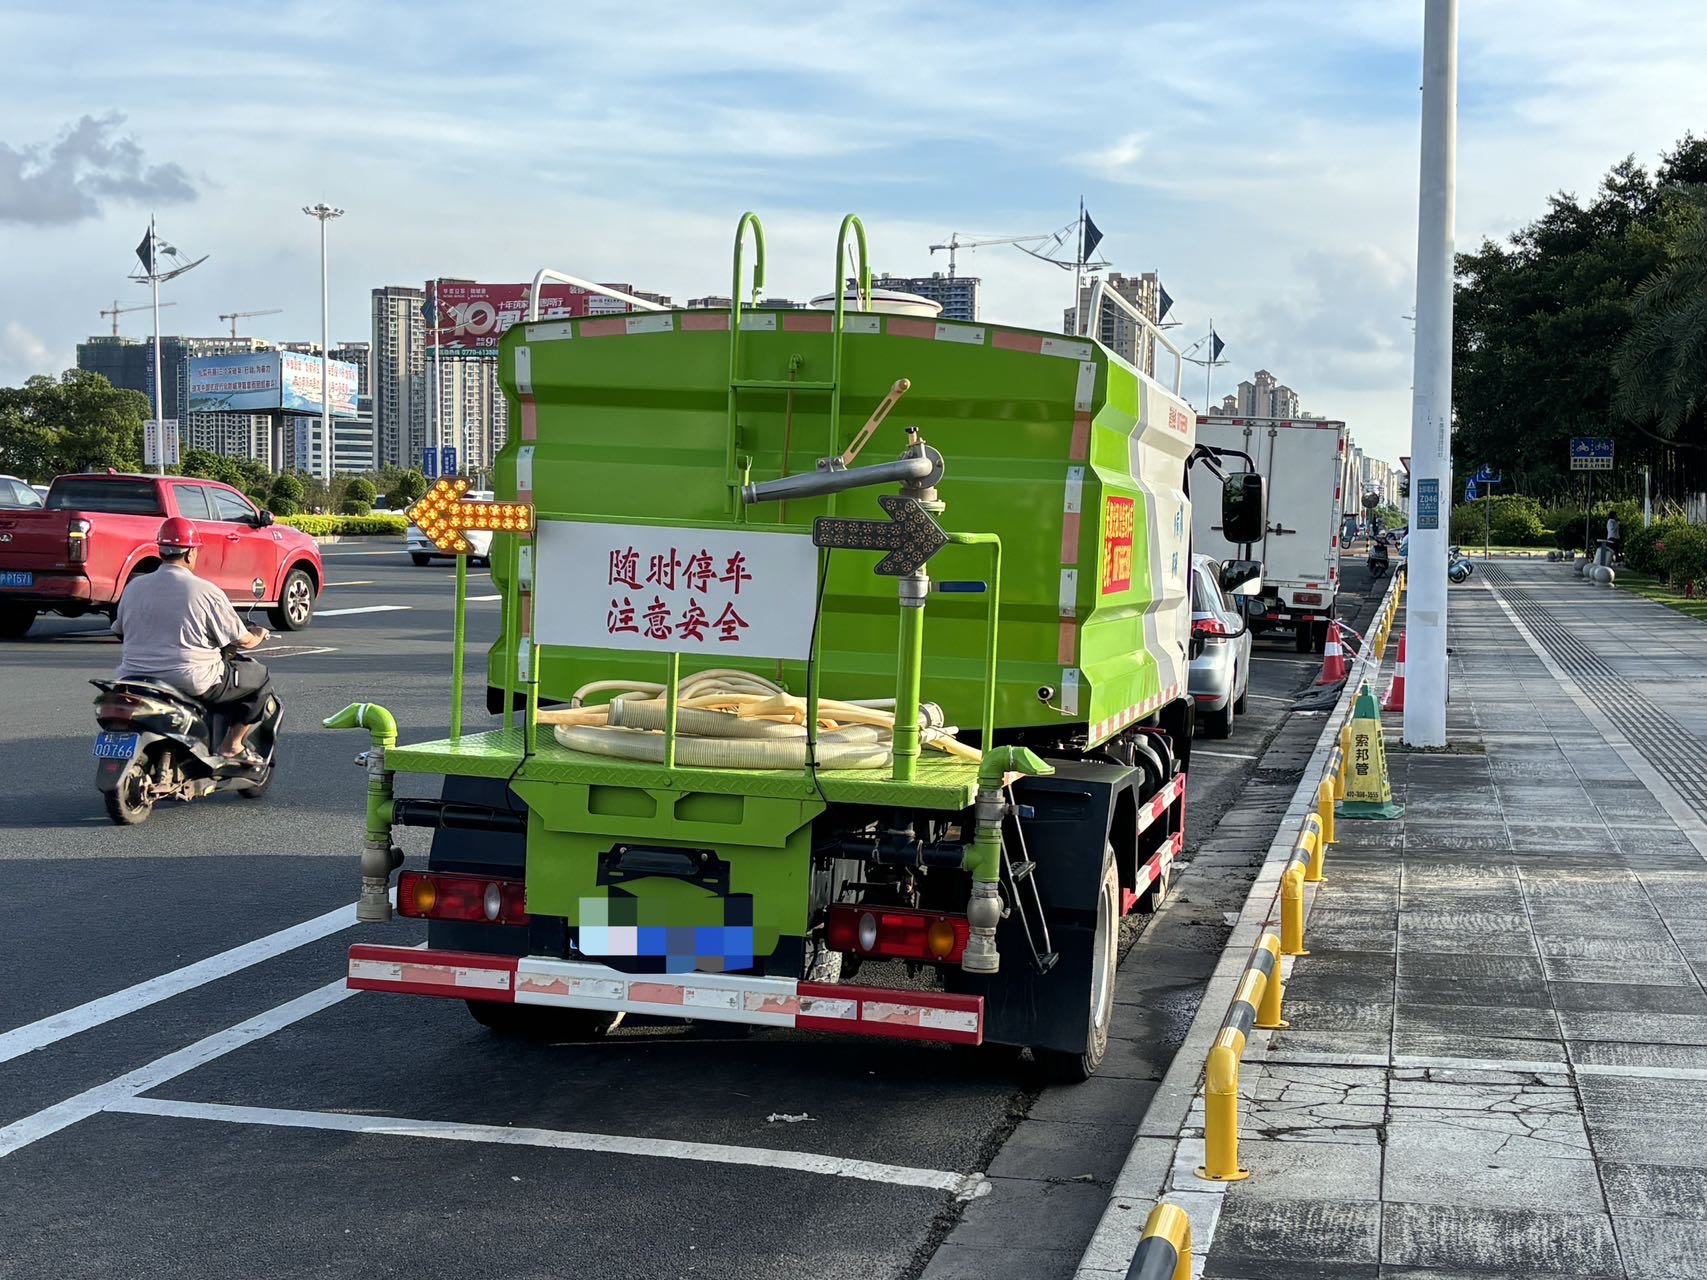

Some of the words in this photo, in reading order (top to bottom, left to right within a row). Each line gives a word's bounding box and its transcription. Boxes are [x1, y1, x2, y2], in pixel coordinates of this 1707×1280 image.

[608, 546, 753, 594] 随时停车
[607, 595, 750, 642] 注意安全
[94, 743, 133, 758] 00766
[1355, 734, 1370, 776] 索邦管
